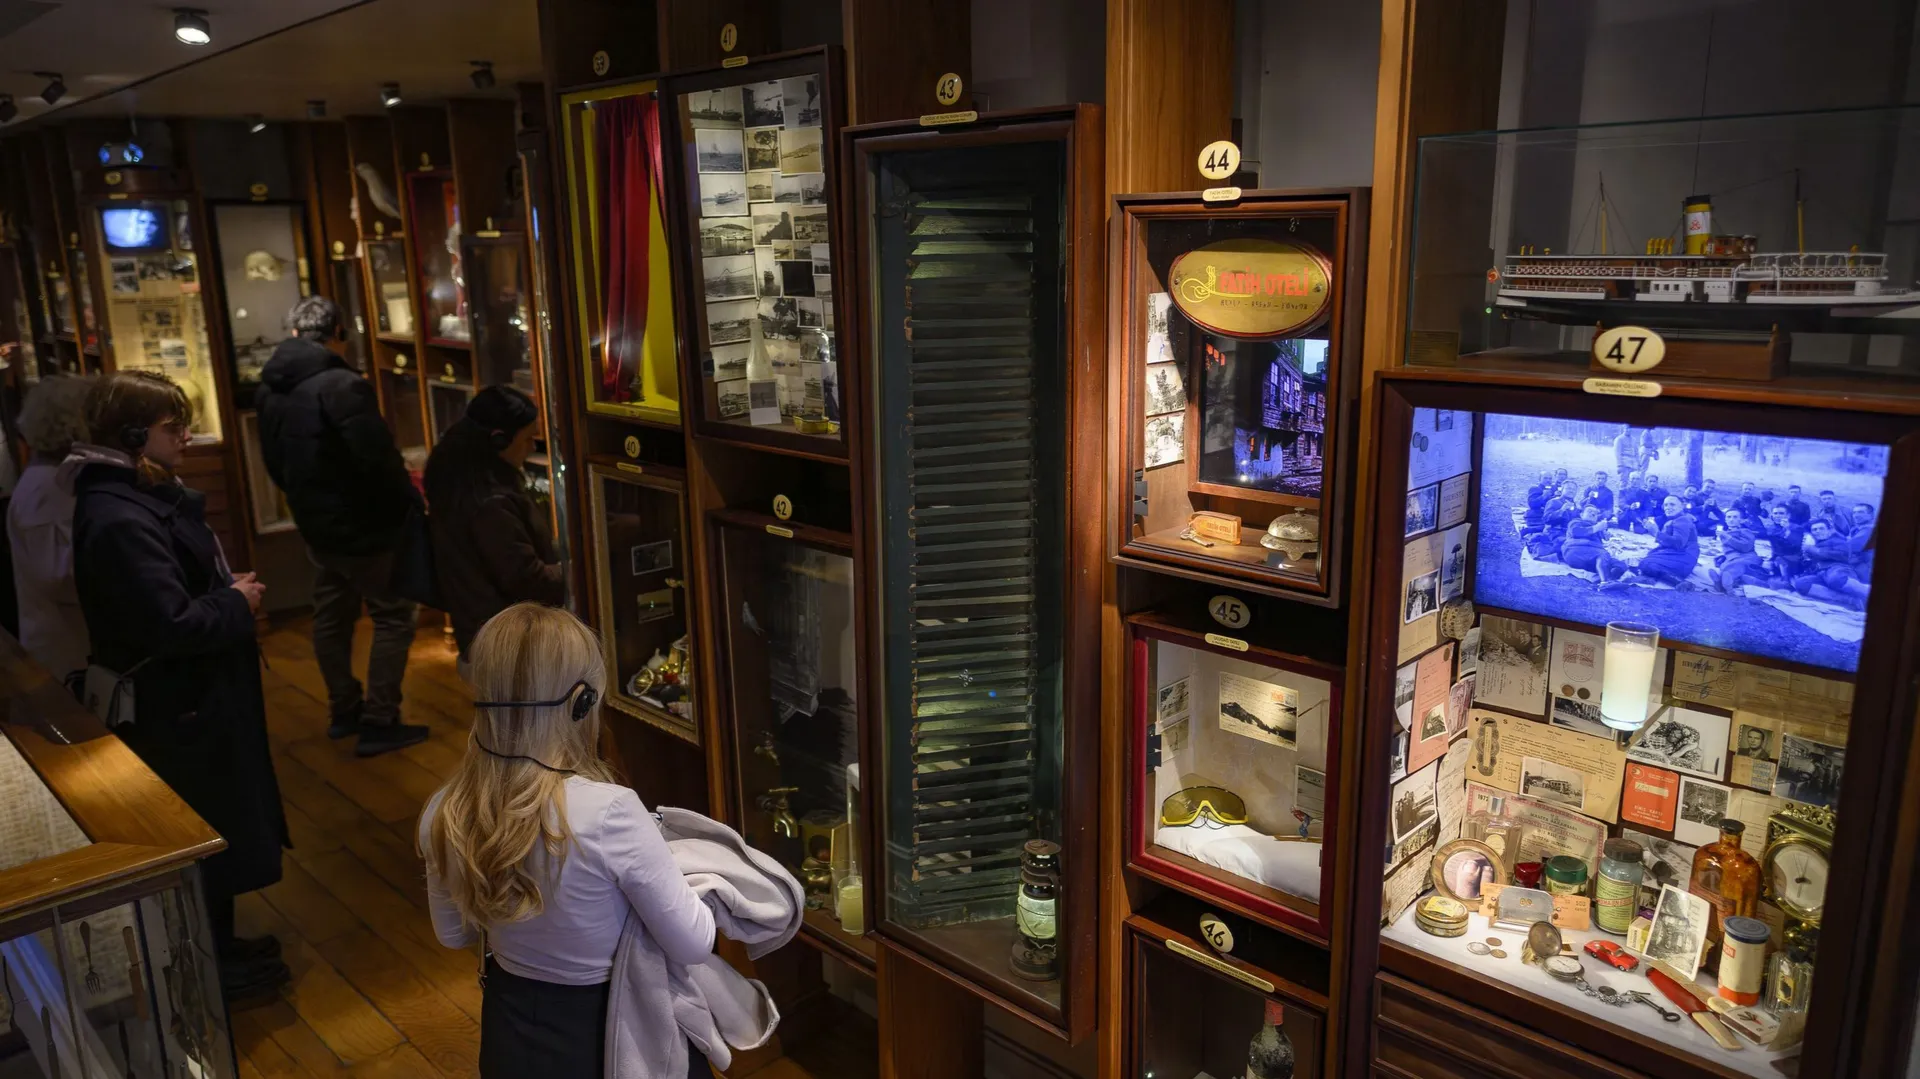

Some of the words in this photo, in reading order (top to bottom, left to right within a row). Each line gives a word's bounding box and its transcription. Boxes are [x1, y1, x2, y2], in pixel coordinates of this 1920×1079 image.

[724, 28, 732, 47] 41
[939, 79, 955, 99] 43
[1205, 148, 1229, 172] 44
[1604, 336, 1648, 364] 47
[626, 440, 636, 454] 40
[776, 501, 788, 516] 42
[1214, 600, 1242, 624] 45
[1203, 922, 1226, 947] 46
